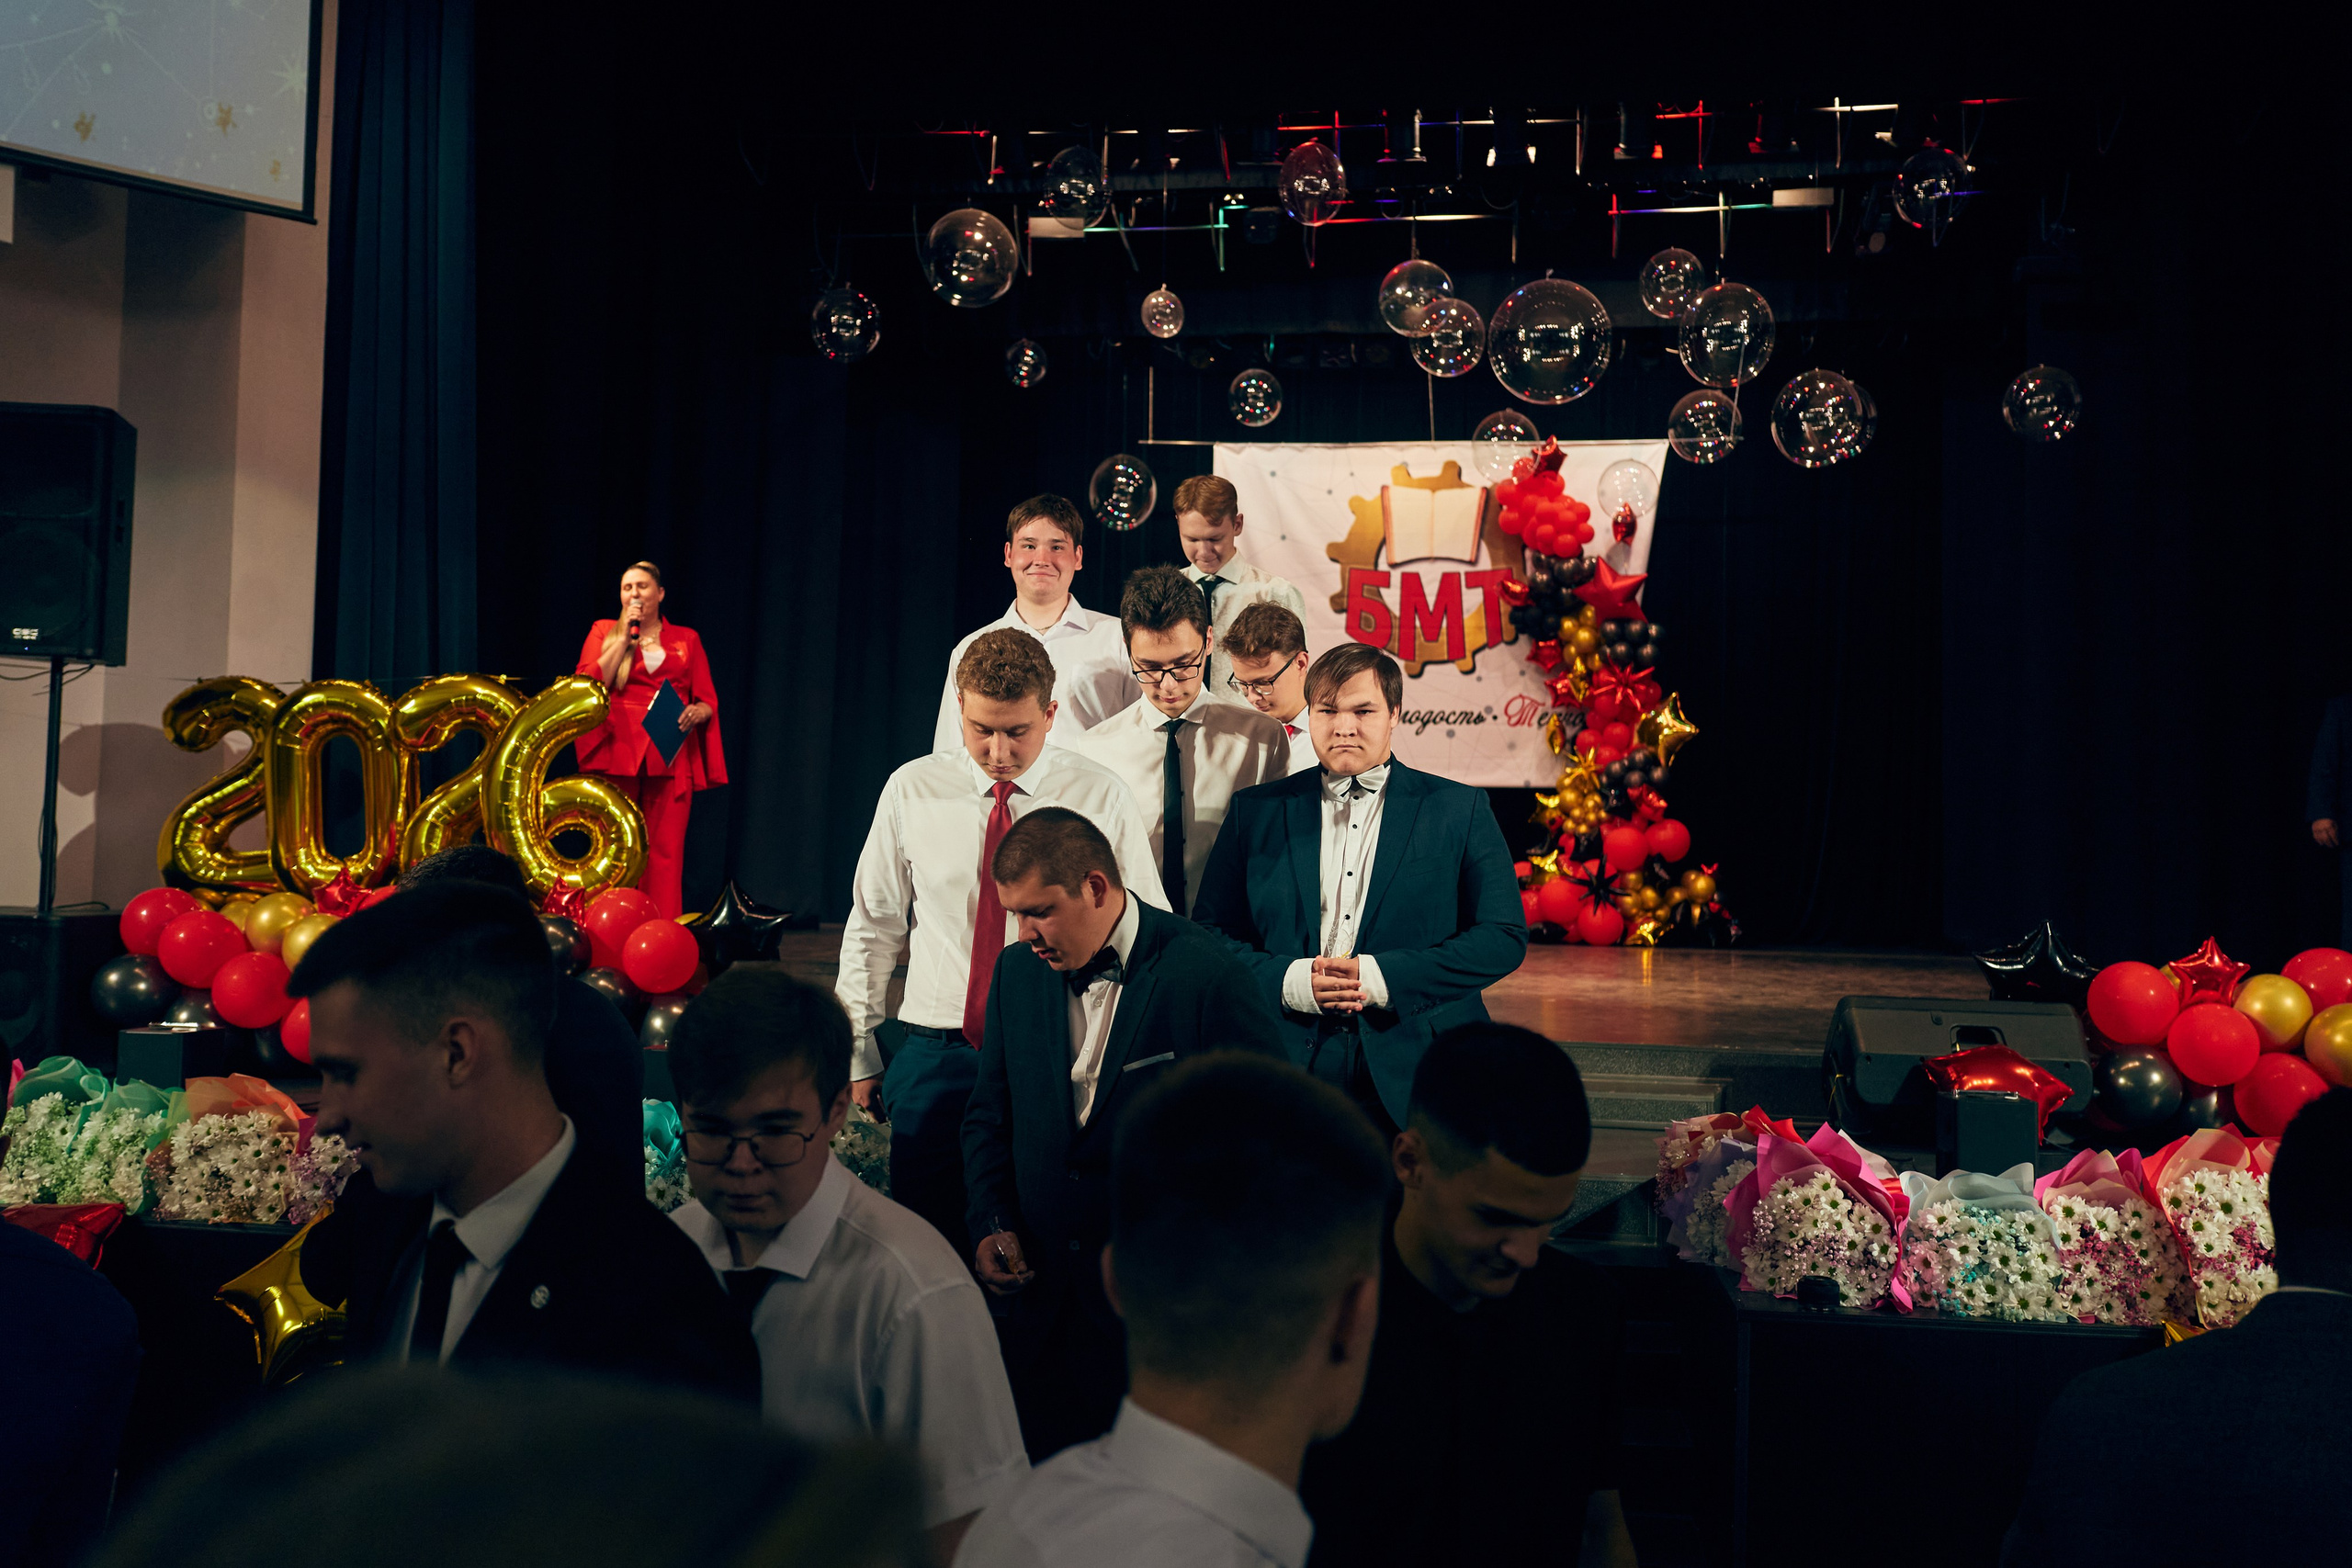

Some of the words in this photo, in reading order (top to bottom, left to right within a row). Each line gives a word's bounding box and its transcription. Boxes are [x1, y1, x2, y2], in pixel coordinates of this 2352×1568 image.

[1345, 569, 1514, 662] БМТ
[1399, 709, 1487, 736] лодость
[161, 674, 648, 902] 2026
